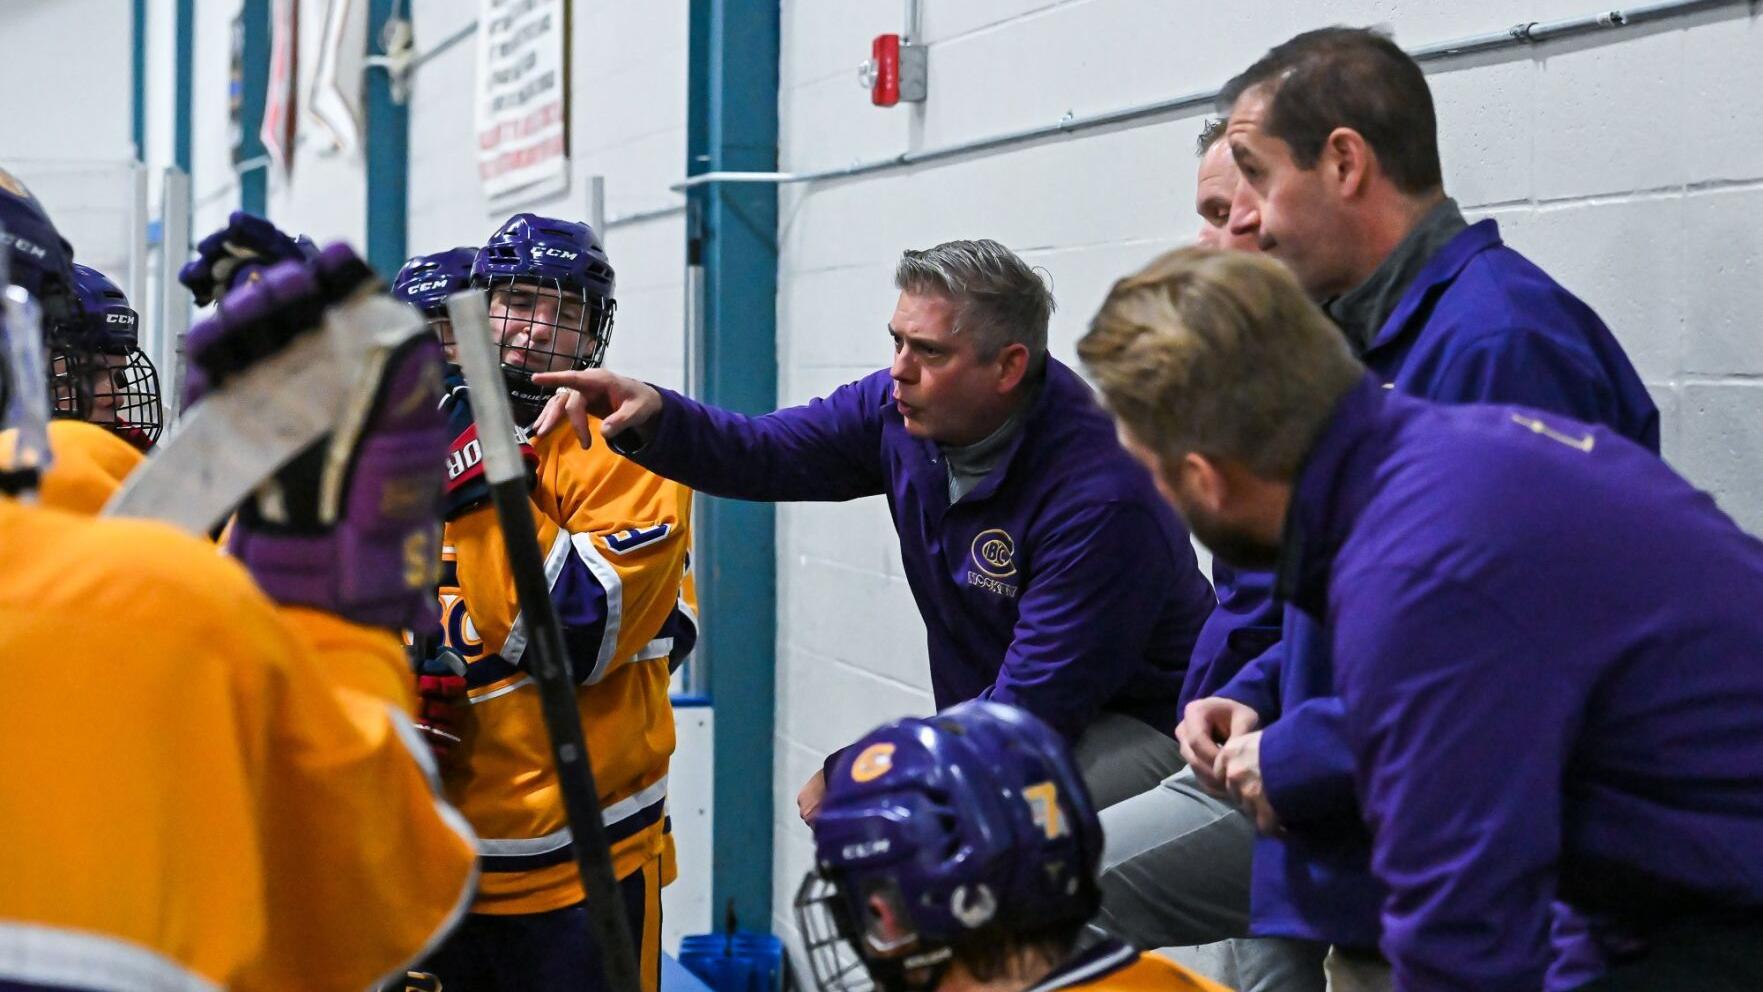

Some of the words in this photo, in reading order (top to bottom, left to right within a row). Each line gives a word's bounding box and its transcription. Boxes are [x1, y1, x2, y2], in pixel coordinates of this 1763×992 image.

[530, 245, 578, 260] CCM
[407, 279, 448, 295] CCM
[106, 313, 135, 325] CCM
[968, 571, 1018, 597] HOCKEY
[1022, 781, 1070, 839] 7
